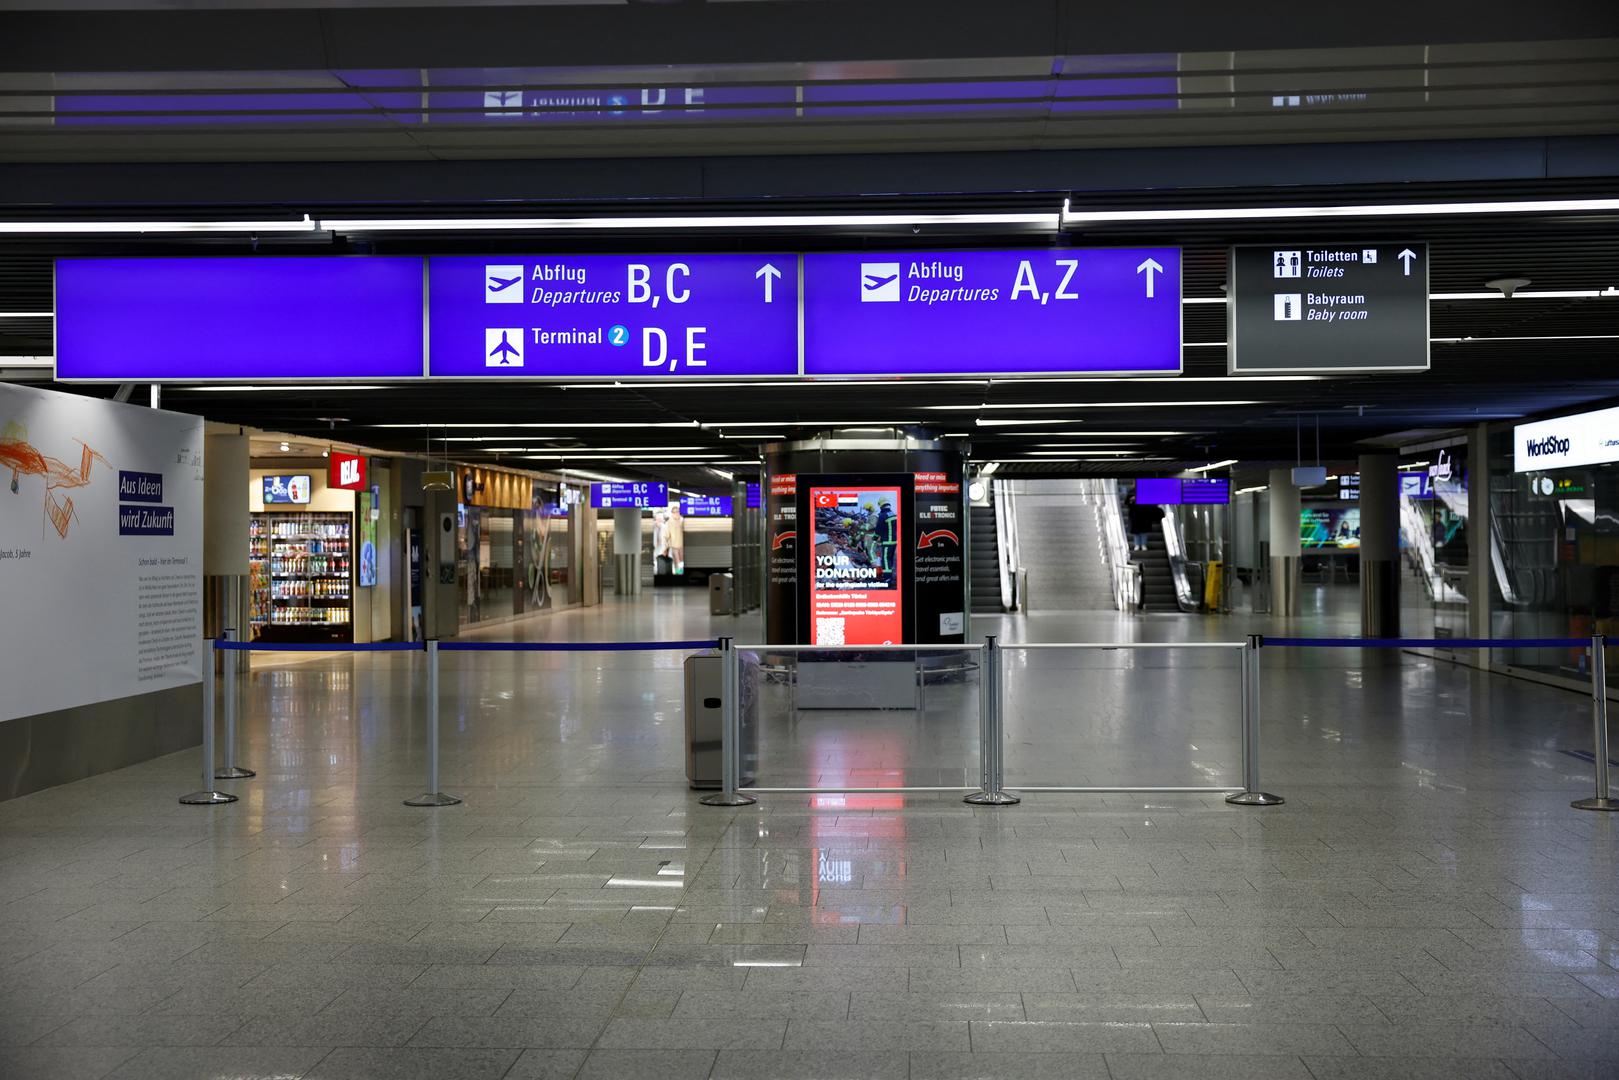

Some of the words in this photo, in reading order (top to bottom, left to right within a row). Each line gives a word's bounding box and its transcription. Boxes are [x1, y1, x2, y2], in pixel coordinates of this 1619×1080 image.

[1306, 250, 1358, 262] Toiletten
[1306, 266, 1345, 278] Toilets
[532, 264, 586, 283] Abflug
[627, 263, 691, 309] B,C
[908, 262, 963, 281] Abflug
[1010, 260, 1079, 305] A,Z
[531, 288, 621, 307] Departures
[908, 286, 999, 305] Departures
[1307, 293, 1365, 307] Babyraum
[1307, 309, 1336, 322] Baby
[1338, 311, 1368, 320] room
[532, 328, 602, 344] Terminal
[613, 328, 624, 344] 2
[642, 327, 707, 372] D,E
[1527, 435, 1570, 457] WorldShop
[120, 476, 136, 495] Aus
[138, 477, 161, 496] Ideen
[121, 509, 140, 528] wird
[141, 510, 173, 529] Zukunft
[816, 556, 849, 566] YOUR
[816, 568, 877, 579] DONATION
